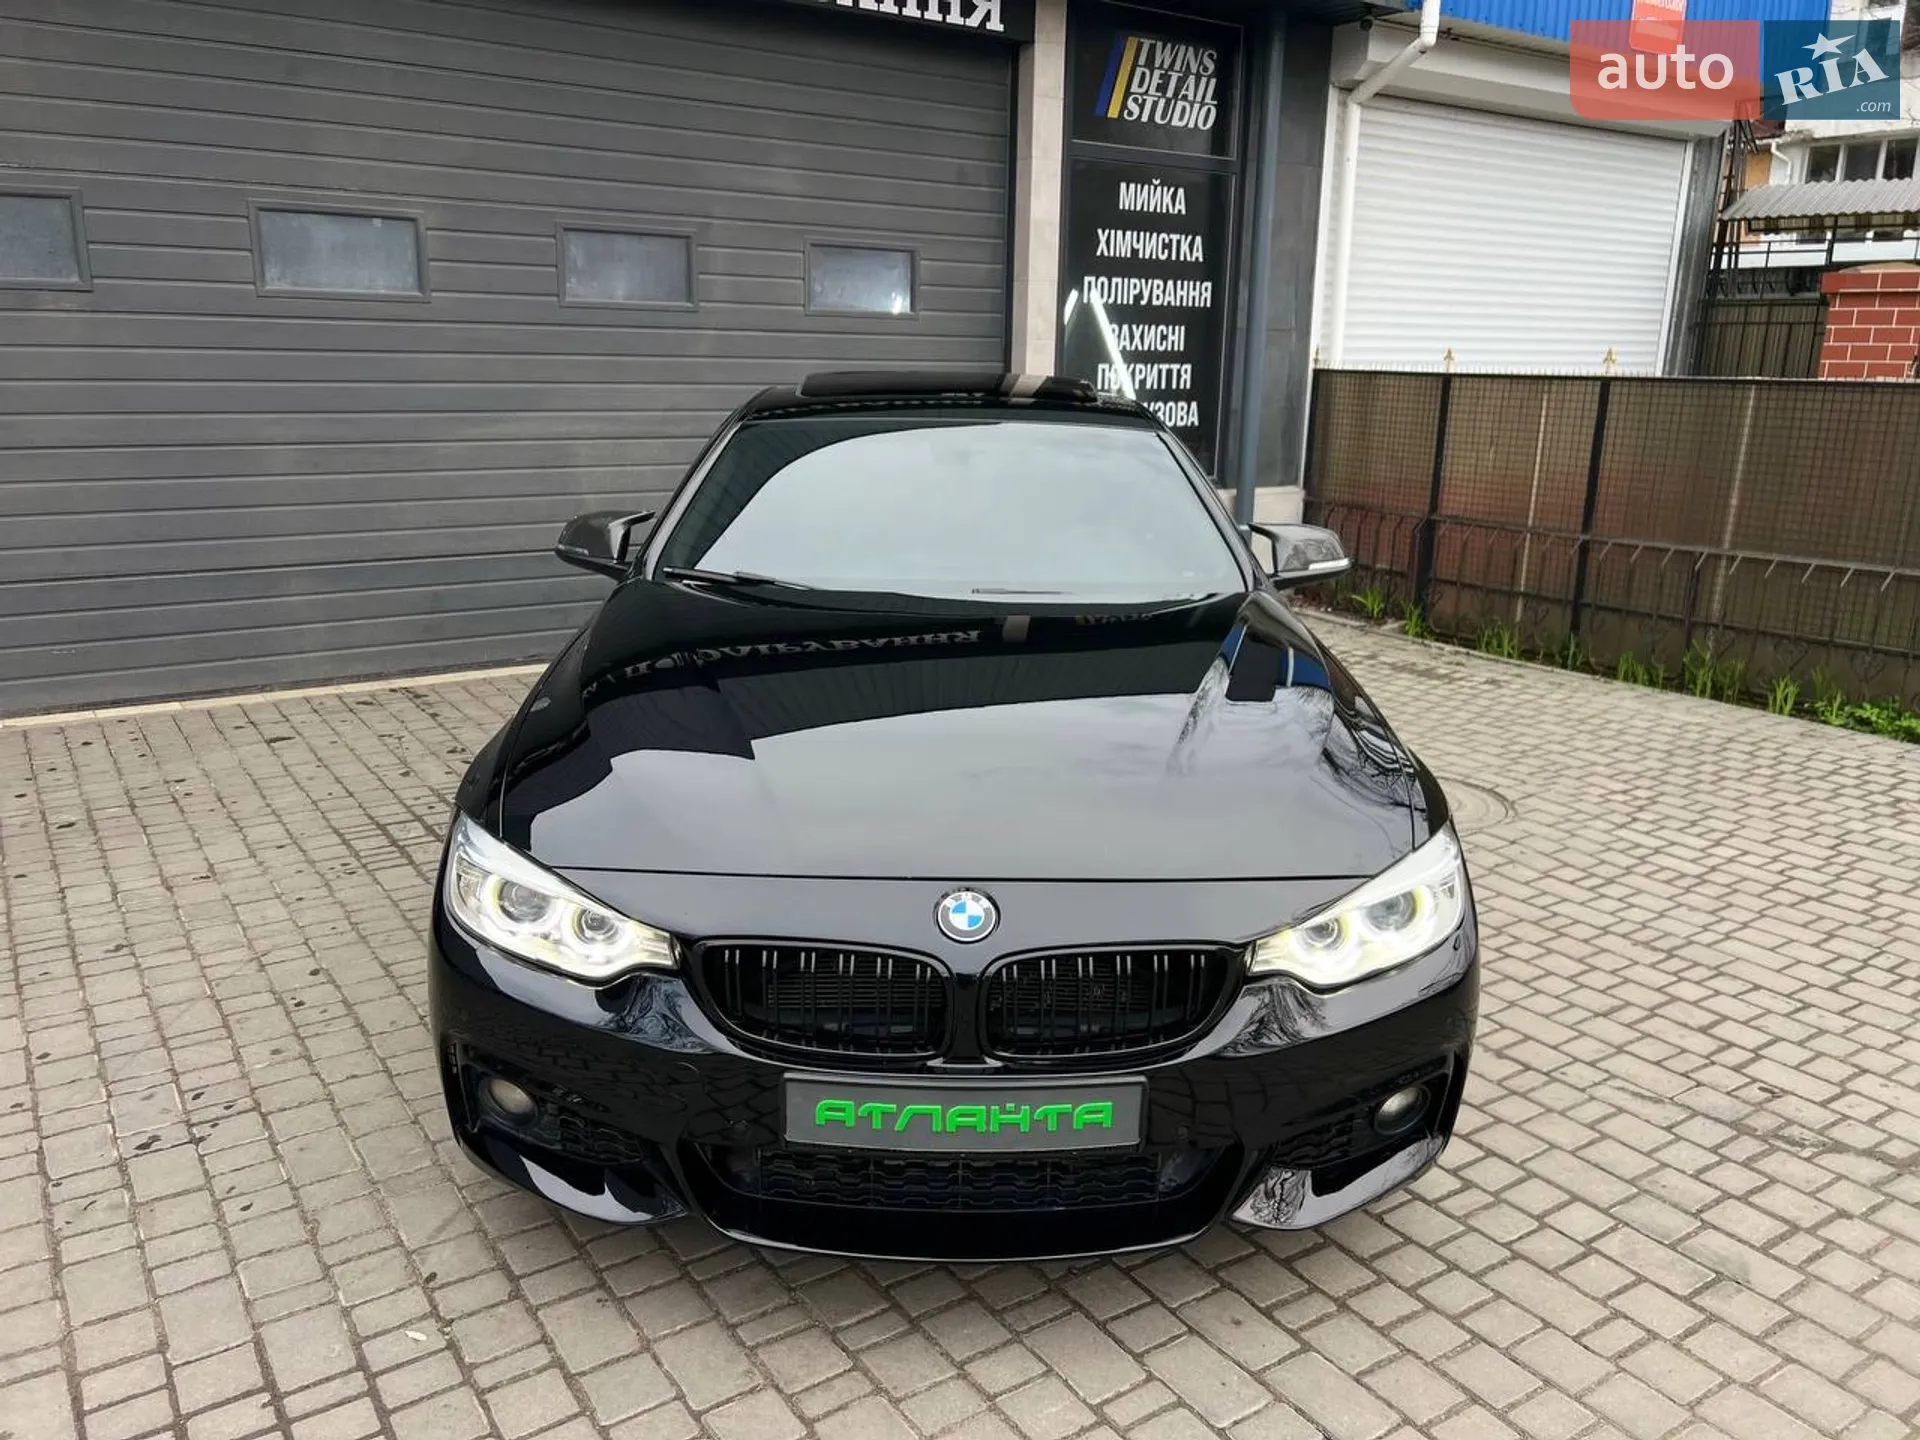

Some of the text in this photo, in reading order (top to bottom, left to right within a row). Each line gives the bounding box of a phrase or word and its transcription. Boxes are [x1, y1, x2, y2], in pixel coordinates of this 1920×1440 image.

[1138, 38, 1217, 75] TWINS
[1130, 66, 1217, 105] DETAIL
[1123, 94, 1217, 130] STUDIO
[1118, 178, 1186, 215] МИЙКА
[1096, 228, 1204, 262] ХІМЧИСТКА
[1083, 275, 1212, 308] ПОЛІРУВАННЯ
